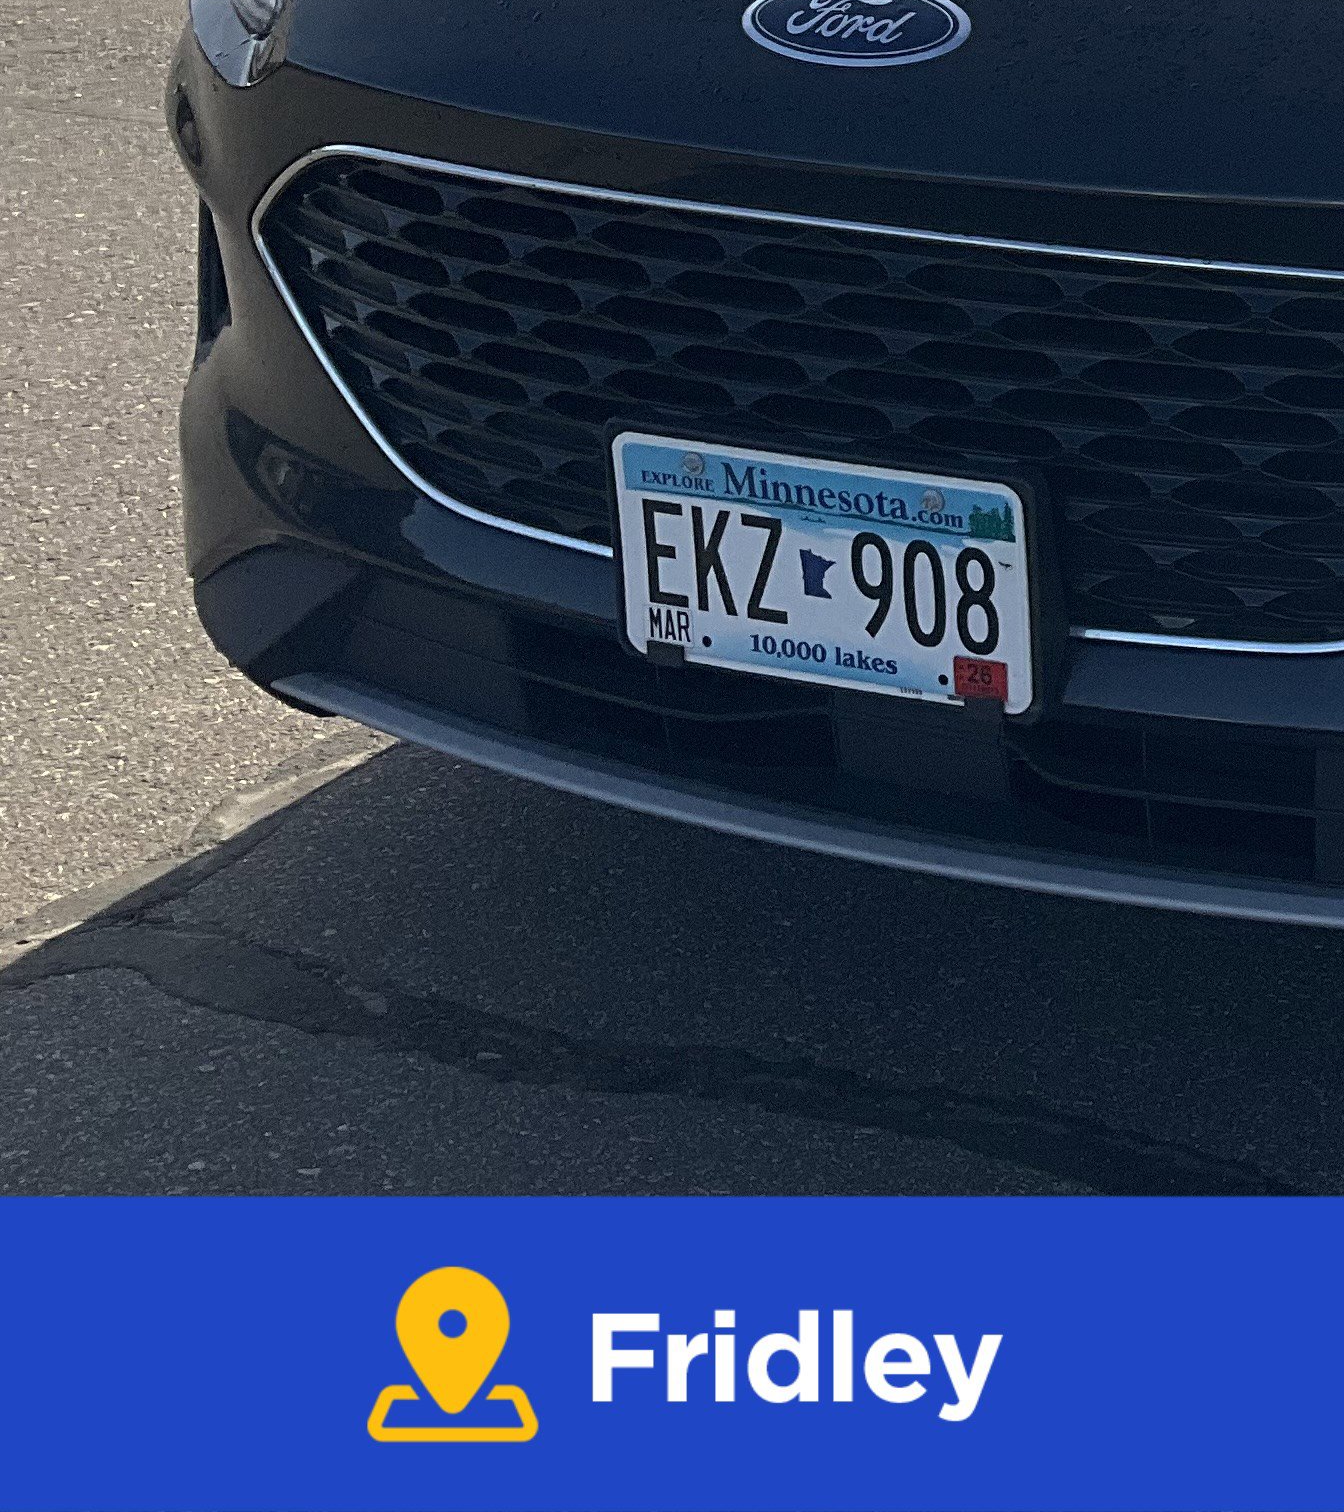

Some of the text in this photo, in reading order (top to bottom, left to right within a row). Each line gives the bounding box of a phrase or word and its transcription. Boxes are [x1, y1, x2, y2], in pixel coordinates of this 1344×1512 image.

[641, 462, 964, 530] EXPLORE Minnesota.com
[642, 498, 1000, 656] EKZ 908
[648, 607, 691, 643] MAR
[749, 633, 899, 676] 10,000 lakes
